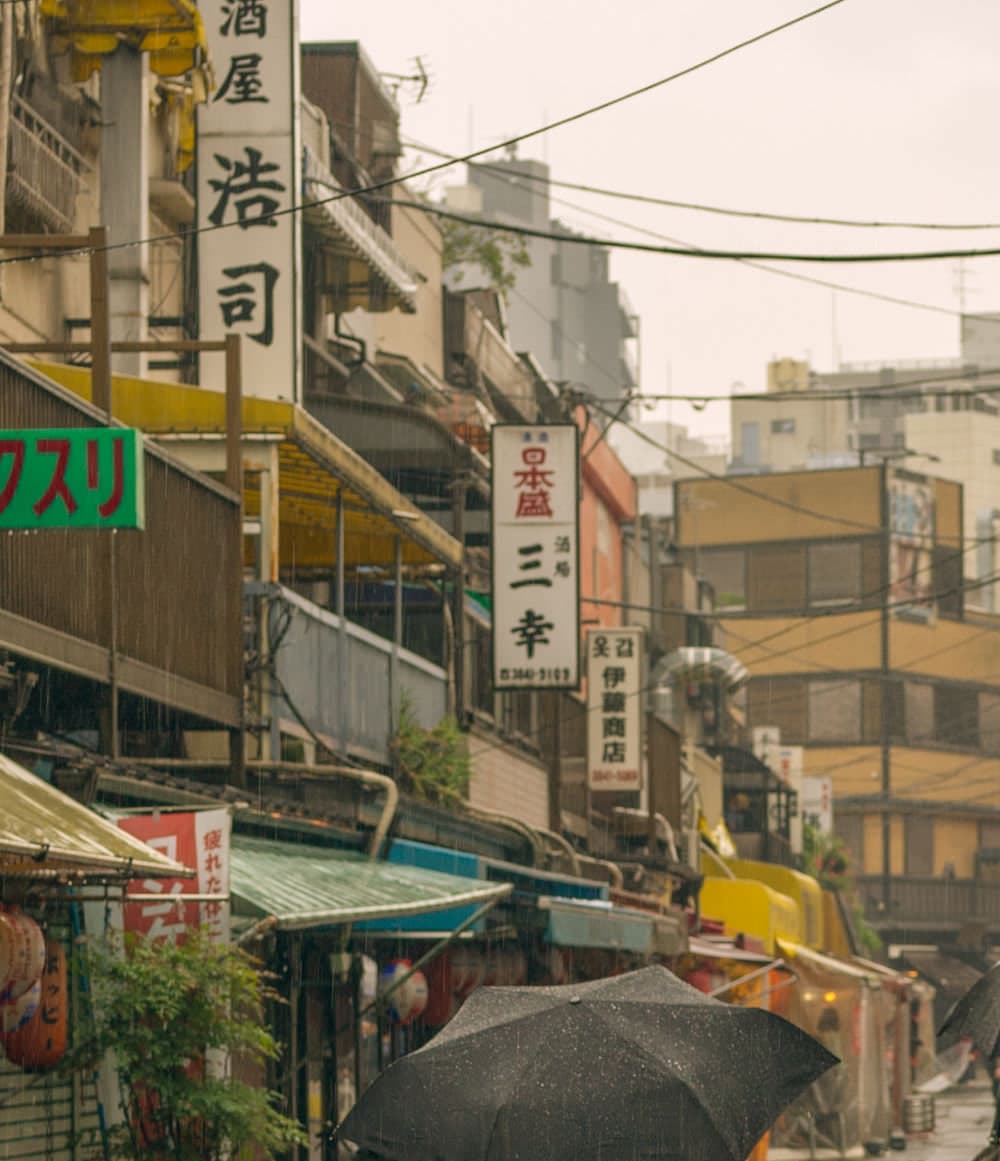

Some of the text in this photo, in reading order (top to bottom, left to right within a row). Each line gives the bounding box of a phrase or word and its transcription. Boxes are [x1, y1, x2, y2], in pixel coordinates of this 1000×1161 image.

[212, 0, 270, 104] 酒屋
[206, 146, 286, 347] 浩司
[513, 447, 556, 518] 日本盛
[509, 543, 554, 659] 三幸
